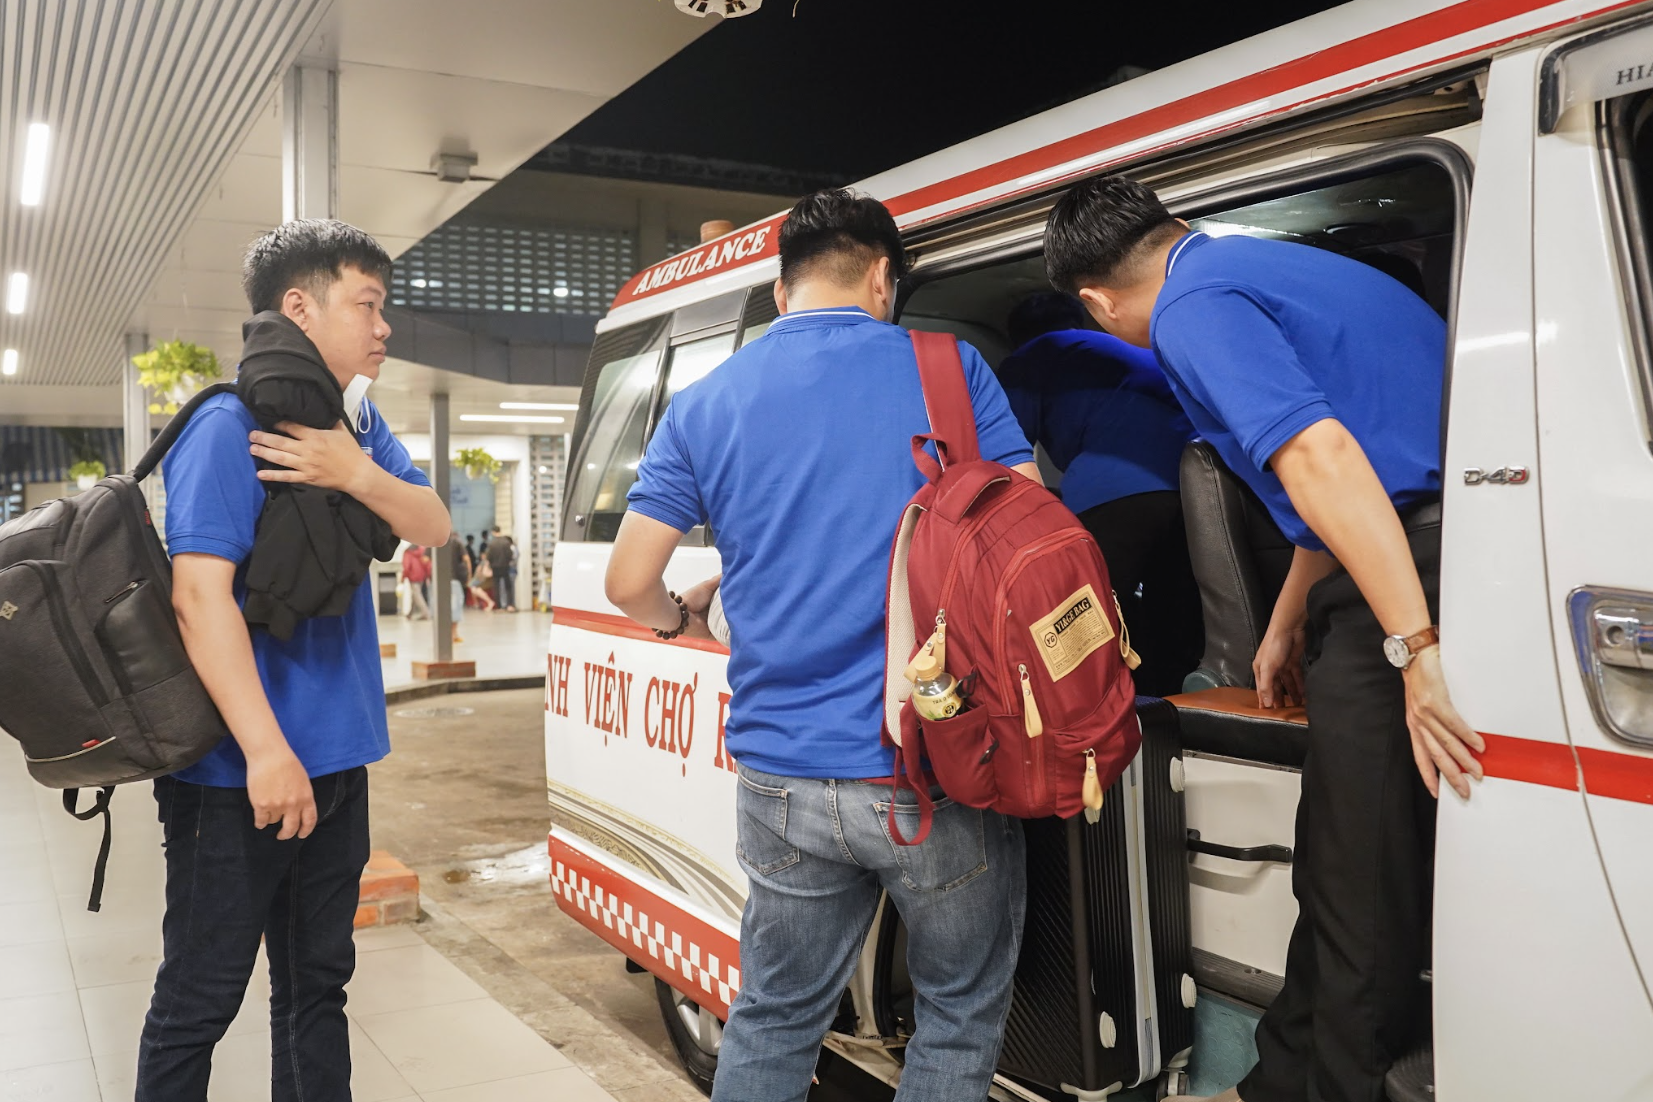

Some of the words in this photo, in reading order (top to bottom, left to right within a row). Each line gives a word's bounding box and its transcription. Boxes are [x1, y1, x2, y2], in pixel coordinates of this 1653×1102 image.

[632, 226, 771, 296] AMBULANCE
[1463, 465, 1530, 486] D-4D
[1073, 599, 1090, 617] BAG
[1046, 635, 1055, 644] YG
[584, 651, 633, 747] VIỆN
[644, 672, 698, 777] CHỢ
[714, 691, 738, 775] R
